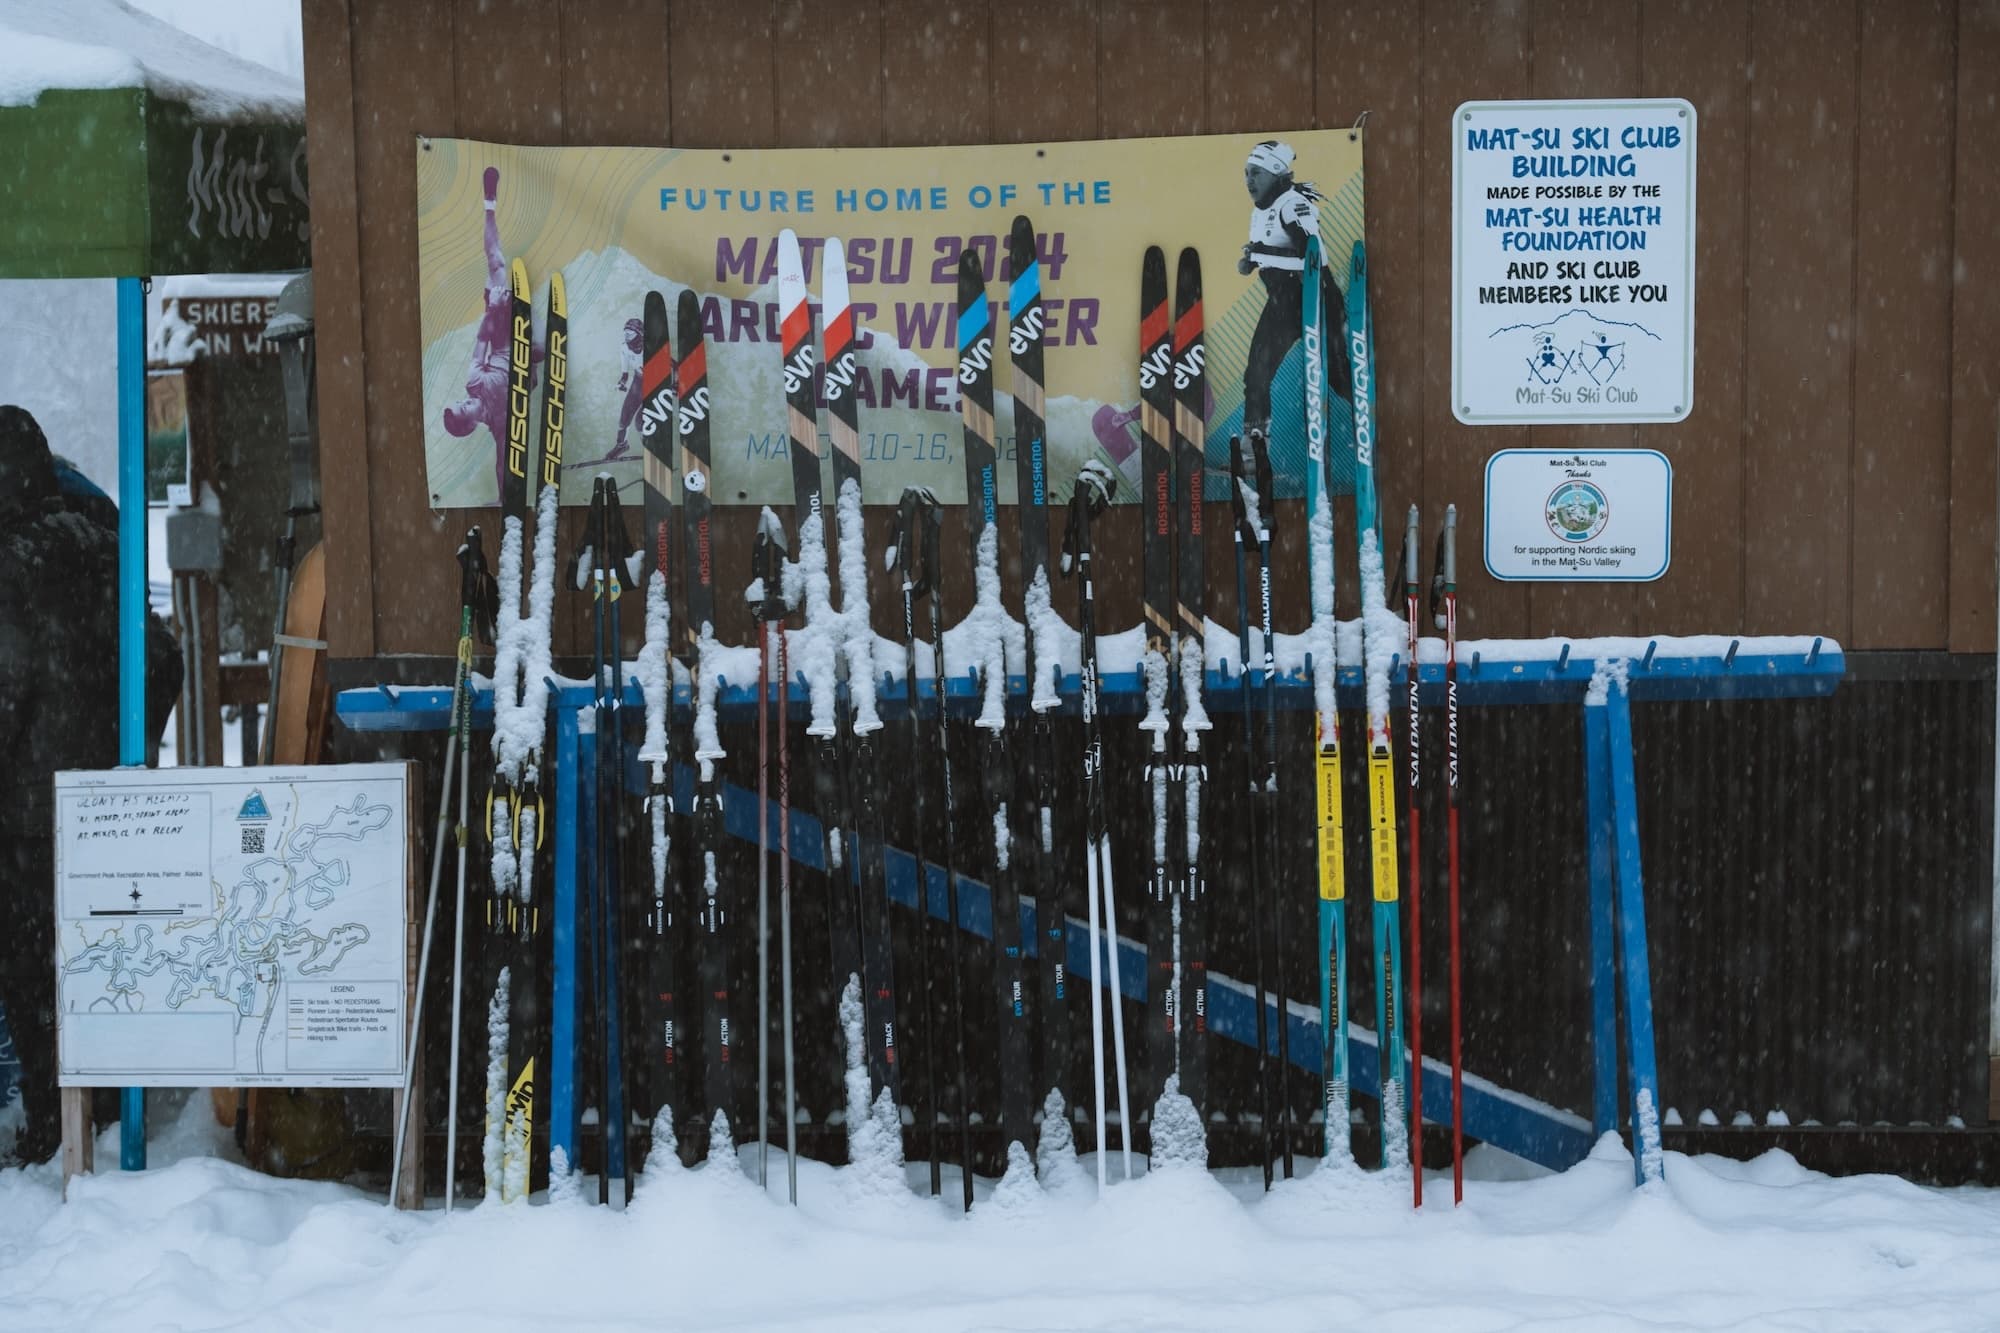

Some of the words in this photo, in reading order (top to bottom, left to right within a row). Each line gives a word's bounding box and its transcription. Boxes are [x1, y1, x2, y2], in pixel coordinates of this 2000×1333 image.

[1468, 128, 1560, 151] MAT-SU
[1573, 127, 1609, 150] SKI
[1621, 126, 1681, 149] CLUB
[1512, 154, 1636, 178] BUILDING
[660, 188, 814, 213] FUTURE
[835, 184, 948, 212] HOME
[968, 183, 1017, 209] OF
[1037, 181, 1112, 206] THE
[1487, 187, 1529, 200] MADE
[1536, 186, 1602, 199] POSSIBLE
[1609, 186, 1627, 198] BY
[1633, 185, 1661, 198] THE
[1486, 207, 1569, 228] MAT-SU
[1578, 206, 1661, 227] HEALTH
[1502, 230, 1646, 251] FOUNDATION
[846, 236, 914, 285] SU
[1507, 262, 1548, 280] AND
[1557, 261, 1585, 279] SKI
[1594, 261, 1640, 279] CLUB
[1479, 285, 1572, 304] MEMBERS
[1580, 285, 1620, 303] LIKE
[1628, 284, 1667, 302] YOU
[895, 298, 1100, 350] WIER
[508, 315, 530, 479] FISCHER
[1304, 324, 1324, 463] ROSSIGNOL
[1351, 329, 1373, 467] ROSSIGNOL
[1516, 388, 1572, 404] Mat-Su
[1577, 387, 1600, 404] Ski
[1606, 386, 1638, 403] Club
[543, 330, 567, 490] FISCHER
[865, 433, 954, 464] 10-16,
[1032, 437, 1045, 506] ROSSIGNOL
[1565, 469, 1592, 478] Thanks
[981, 463, 995, 524] OSSIGNOL
[1158, 470, 1169, 536] ROSSIGNOL
[1191, 471, 1202, 536] ROSSIGNOL
[699, 515, 711, 586] ROSSIGNOL
[1514, 546, 1527, 554] for
[1529, 546, 1576, 556] supporting
[1578, 546, 1608, 554] Nordic
[1610, 546, 1636, 556] skiing
[1531, 558, 1541, 566] in
[1542, 558, 1557, 566] the
[1559, 558, 1592, 566] Mat-Su
[1594, 558, 1622, 568] Valley
[1261, 566, 1271, 636] SALOMON
[1410, 680, 1420, 790] SALOMON
[1449, 680, 1459, 790] SALOMON
[153, 825, 183, 835] RELAY
[1055, 963, 1064, 984] TOUR
[1013, 981, 1021, 1002] TOUR
[1165, 989, 1173, 1016] ACTION
[1196, 989, 1205, 1017] ACTION
[1330, 953, 1339, 1027] UNIVERSE
[1385, 954, 1394, 1029] UNIVERSE
[664, 1020, 673, 1048] ACTION
[720, 1018, 729, 1046] ACTION
[885, 1022, 894, 1047] TRACK
